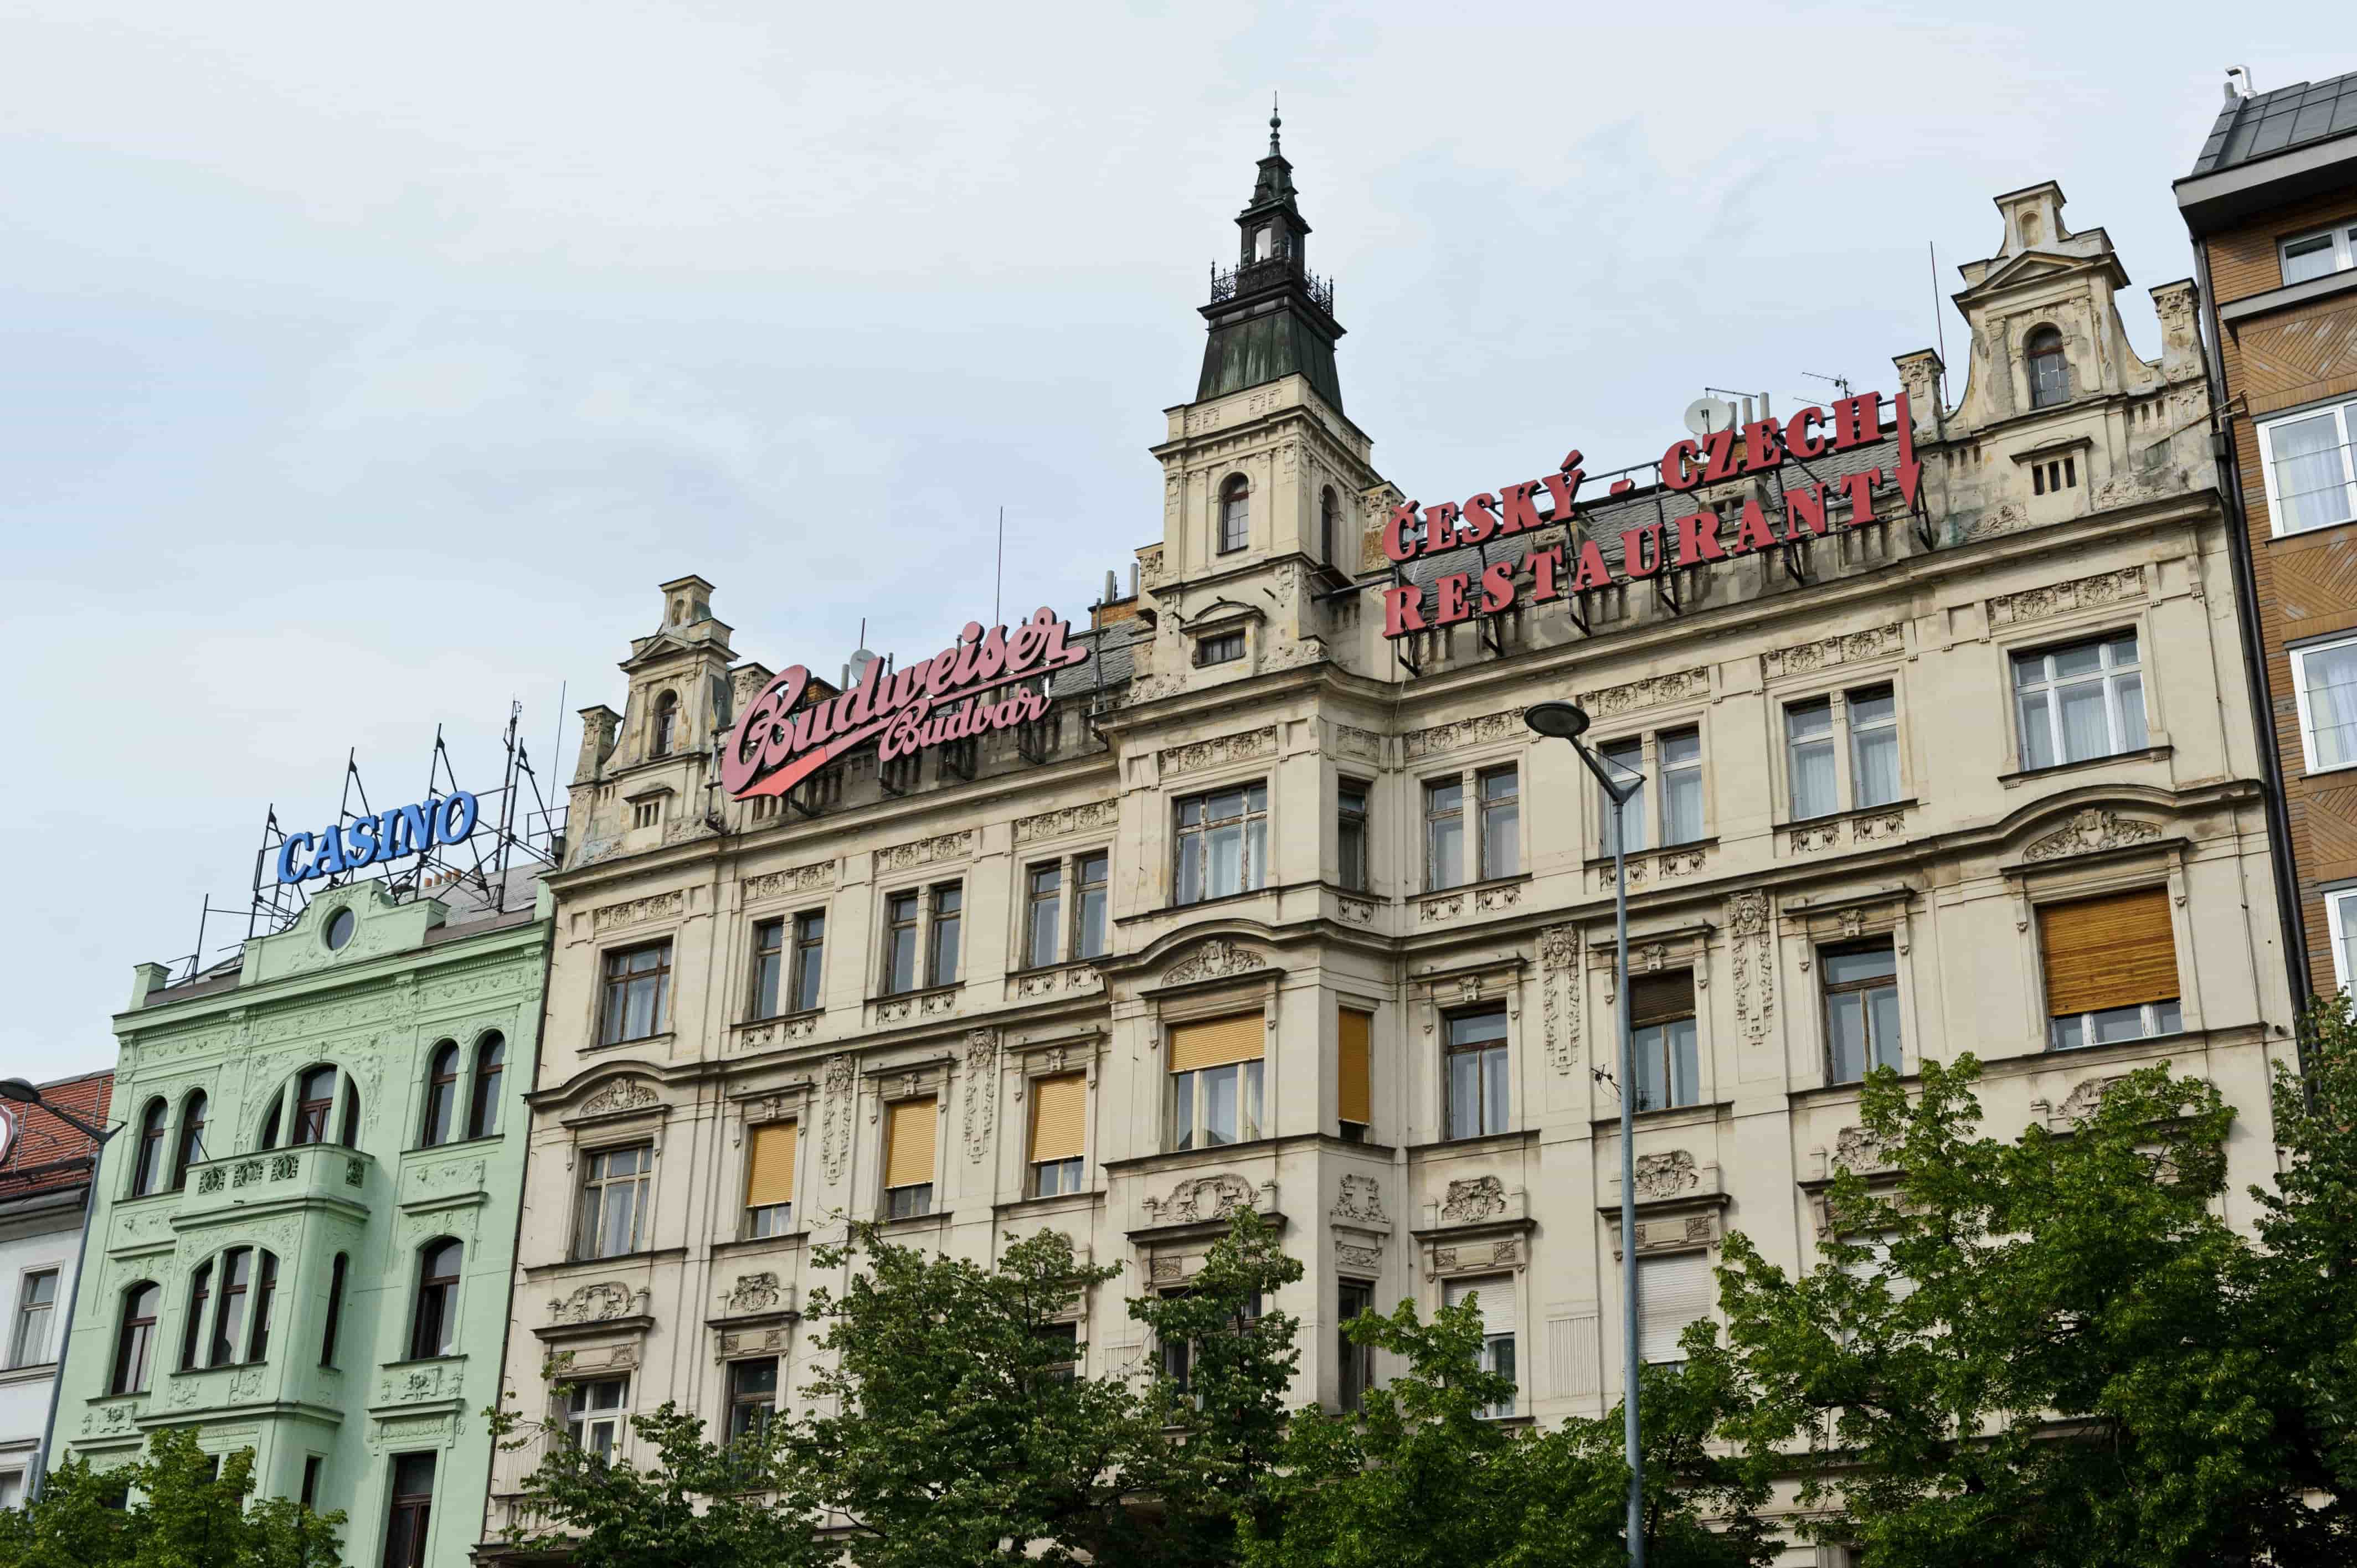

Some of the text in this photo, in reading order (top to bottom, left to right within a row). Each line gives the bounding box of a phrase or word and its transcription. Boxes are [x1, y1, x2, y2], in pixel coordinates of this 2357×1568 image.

[1382, 448, 1586, 563] ČESKÝ
[1661, 390, 1884, 492] CZECH
[1382, 466, 1884, 639] RESTAURANT
[722, 606, 1090, 795] Budweiser
[878, 687, 1052, 762] Budvar
[277, 791, 478, 884] CASINO
